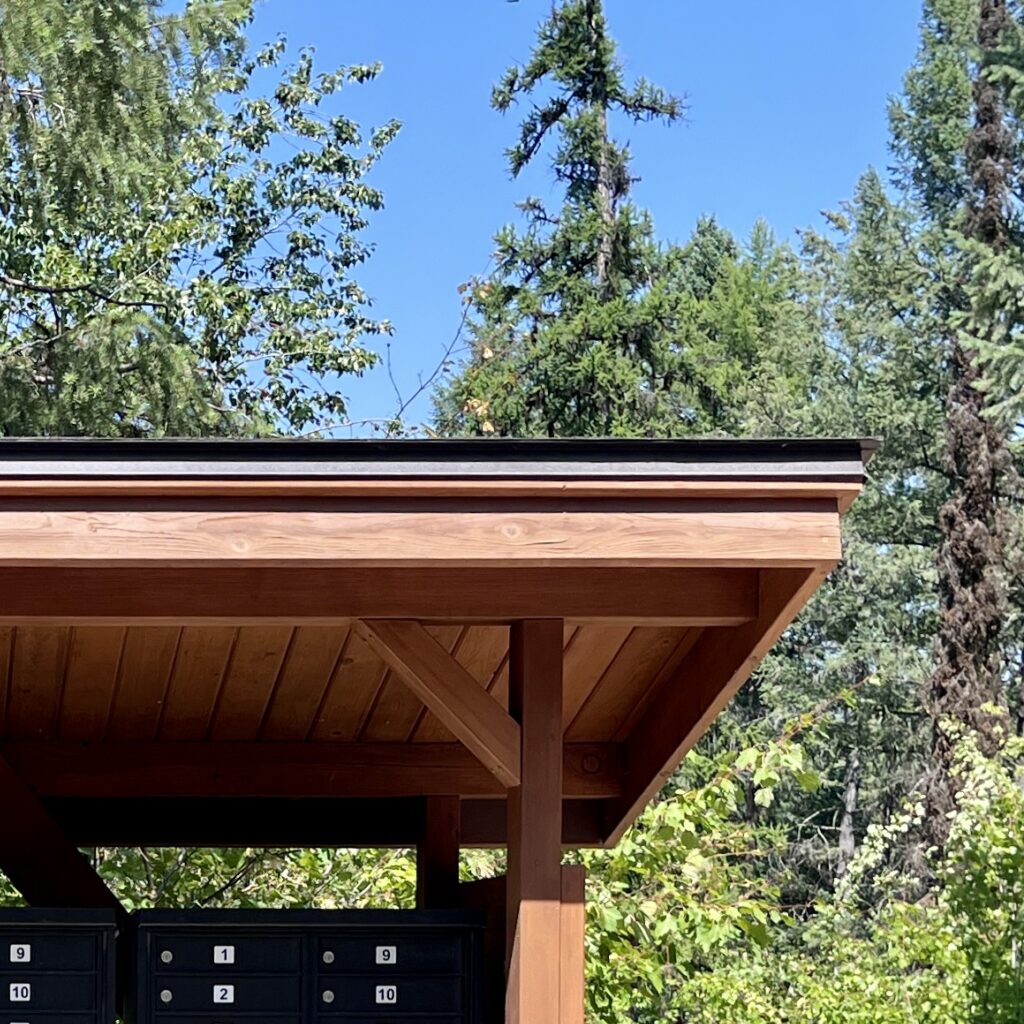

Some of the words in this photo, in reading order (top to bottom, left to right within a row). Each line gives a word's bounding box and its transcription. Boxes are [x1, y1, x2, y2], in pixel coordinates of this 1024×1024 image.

[16, 947, 26, 960] 9
[220, 948, 228, 961] 1
[382, 949, 391, 962] 9
[12, 986, 29, 999] 10
[219, 988, 229, 1001] 2
[378, 988, 395, 1001] 10
